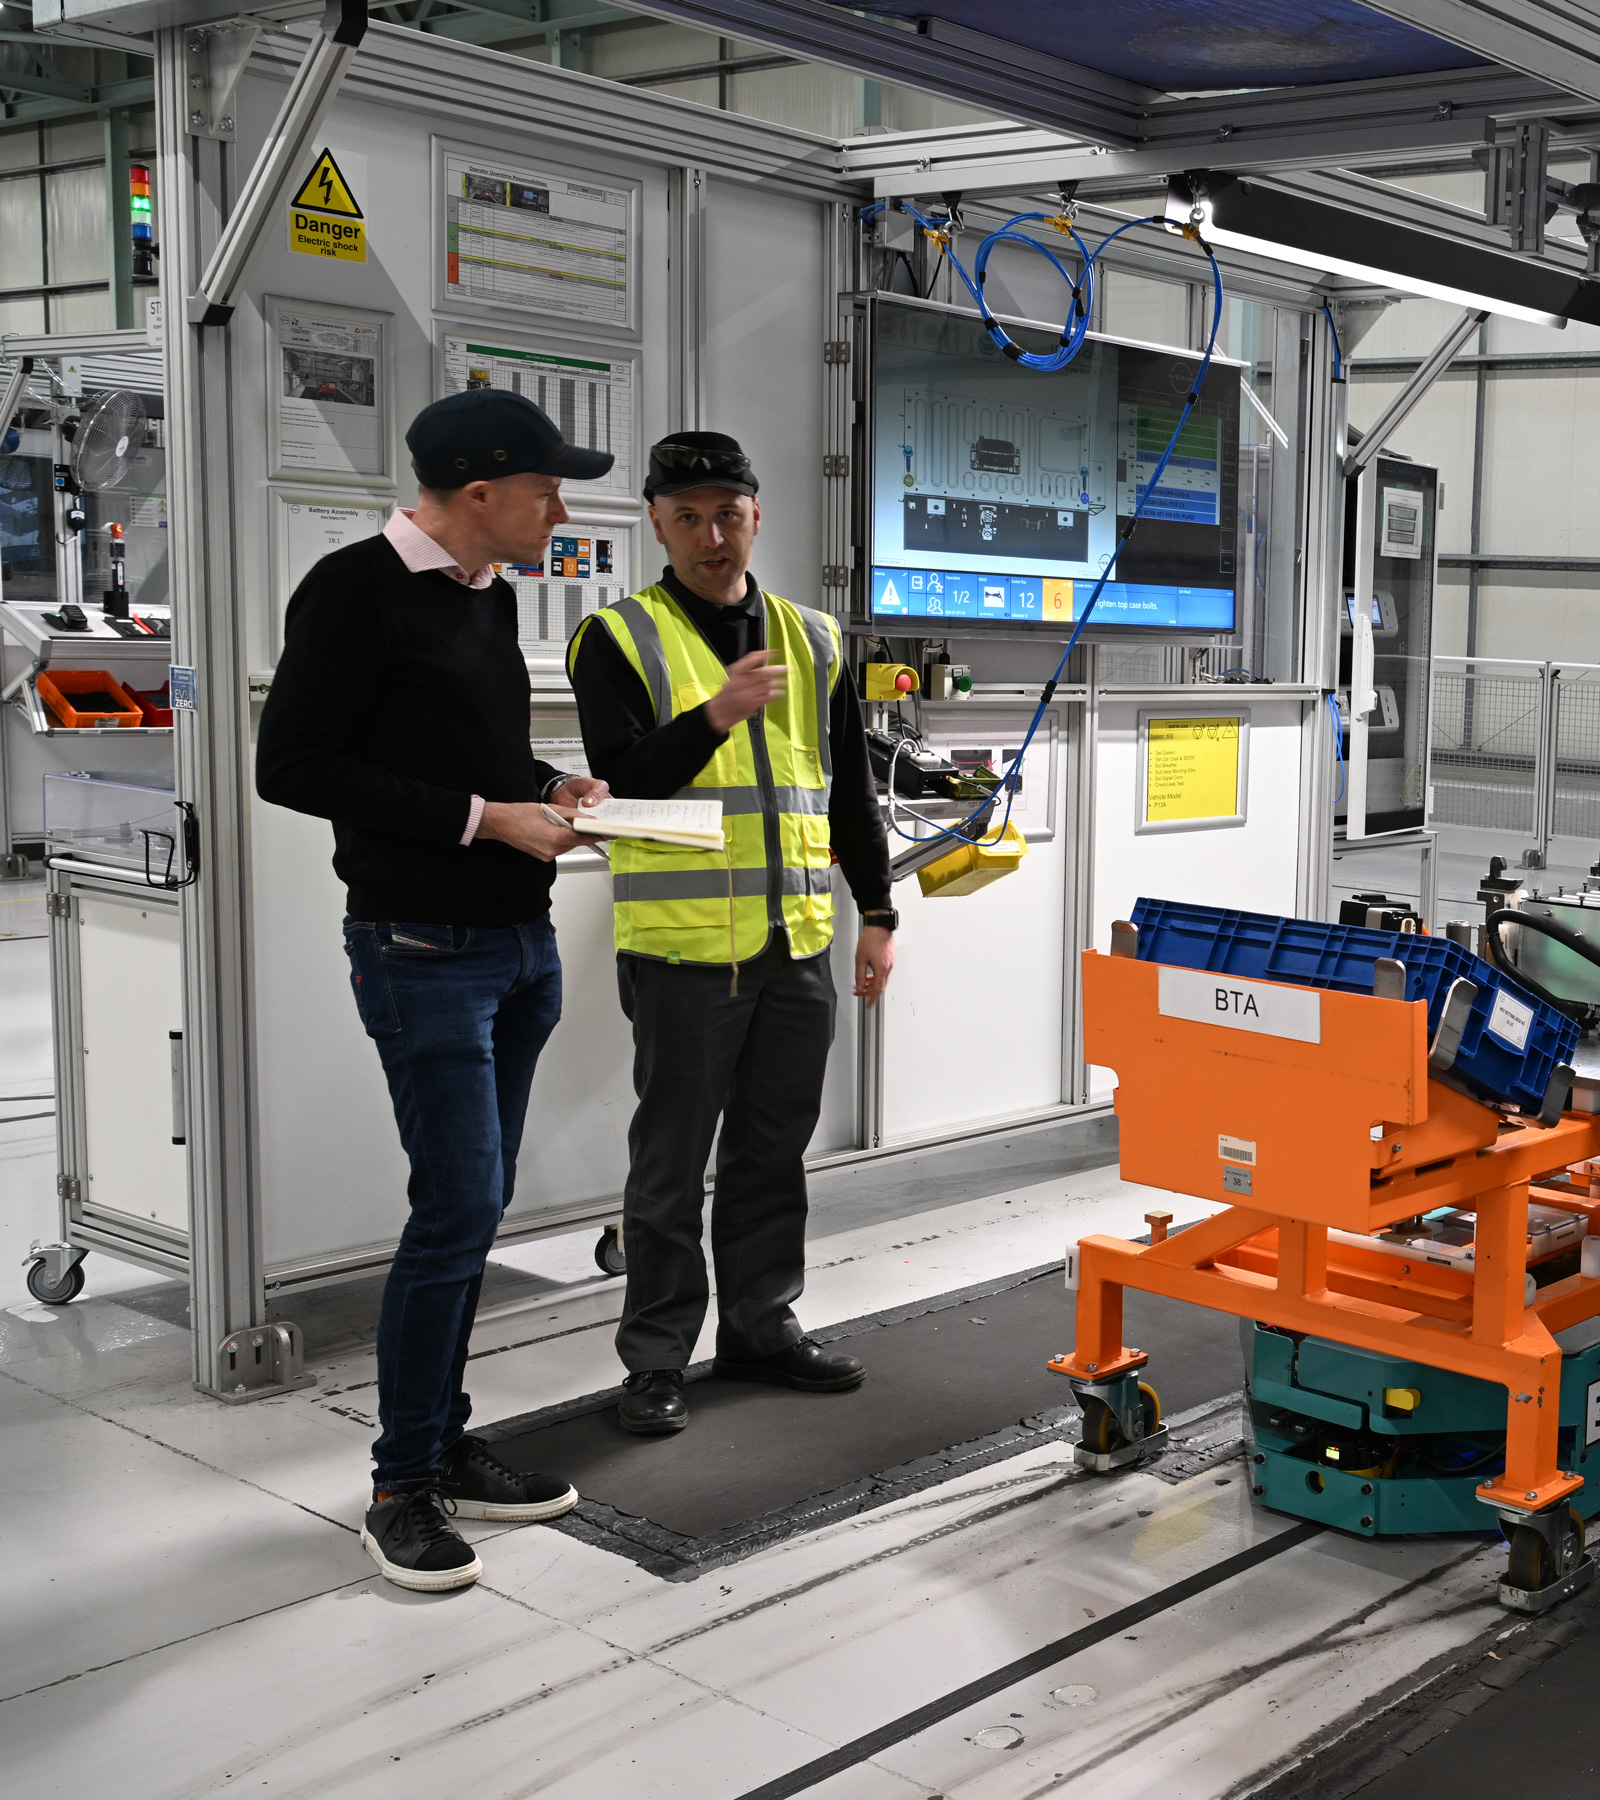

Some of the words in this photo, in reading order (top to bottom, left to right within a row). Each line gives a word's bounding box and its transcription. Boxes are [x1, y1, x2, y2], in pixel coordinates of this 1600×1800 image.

[469, 165, 490, 174] Operator
[490, 170, 512, 180] Downtime
[512, 174, 547, 188] Responsibilities
[295, 213, 361, 240] Danger
[298, 234, 330, 248] Electric
[332, 241, 358, 252] shock
[320, 247, 336, 256] risk
[1168, 373, 1194, 382] NISSAN
[308, 506, 330, 514] Battery
[331, 508, 358, 516] Assembly
[953, 590, 970, 604] 1/2
[1019, 592, 1034, 608] 12
[1054, 592, 1062, 609] 6
[1118, 601, 1127, 610] top
[1142, 601, 1158, 610] bolts.
[175, 699, 192, 708] ZERO
[1215, 988, 1260, 1018] BTA
[1233, 1178, 1241, 1186] 38
